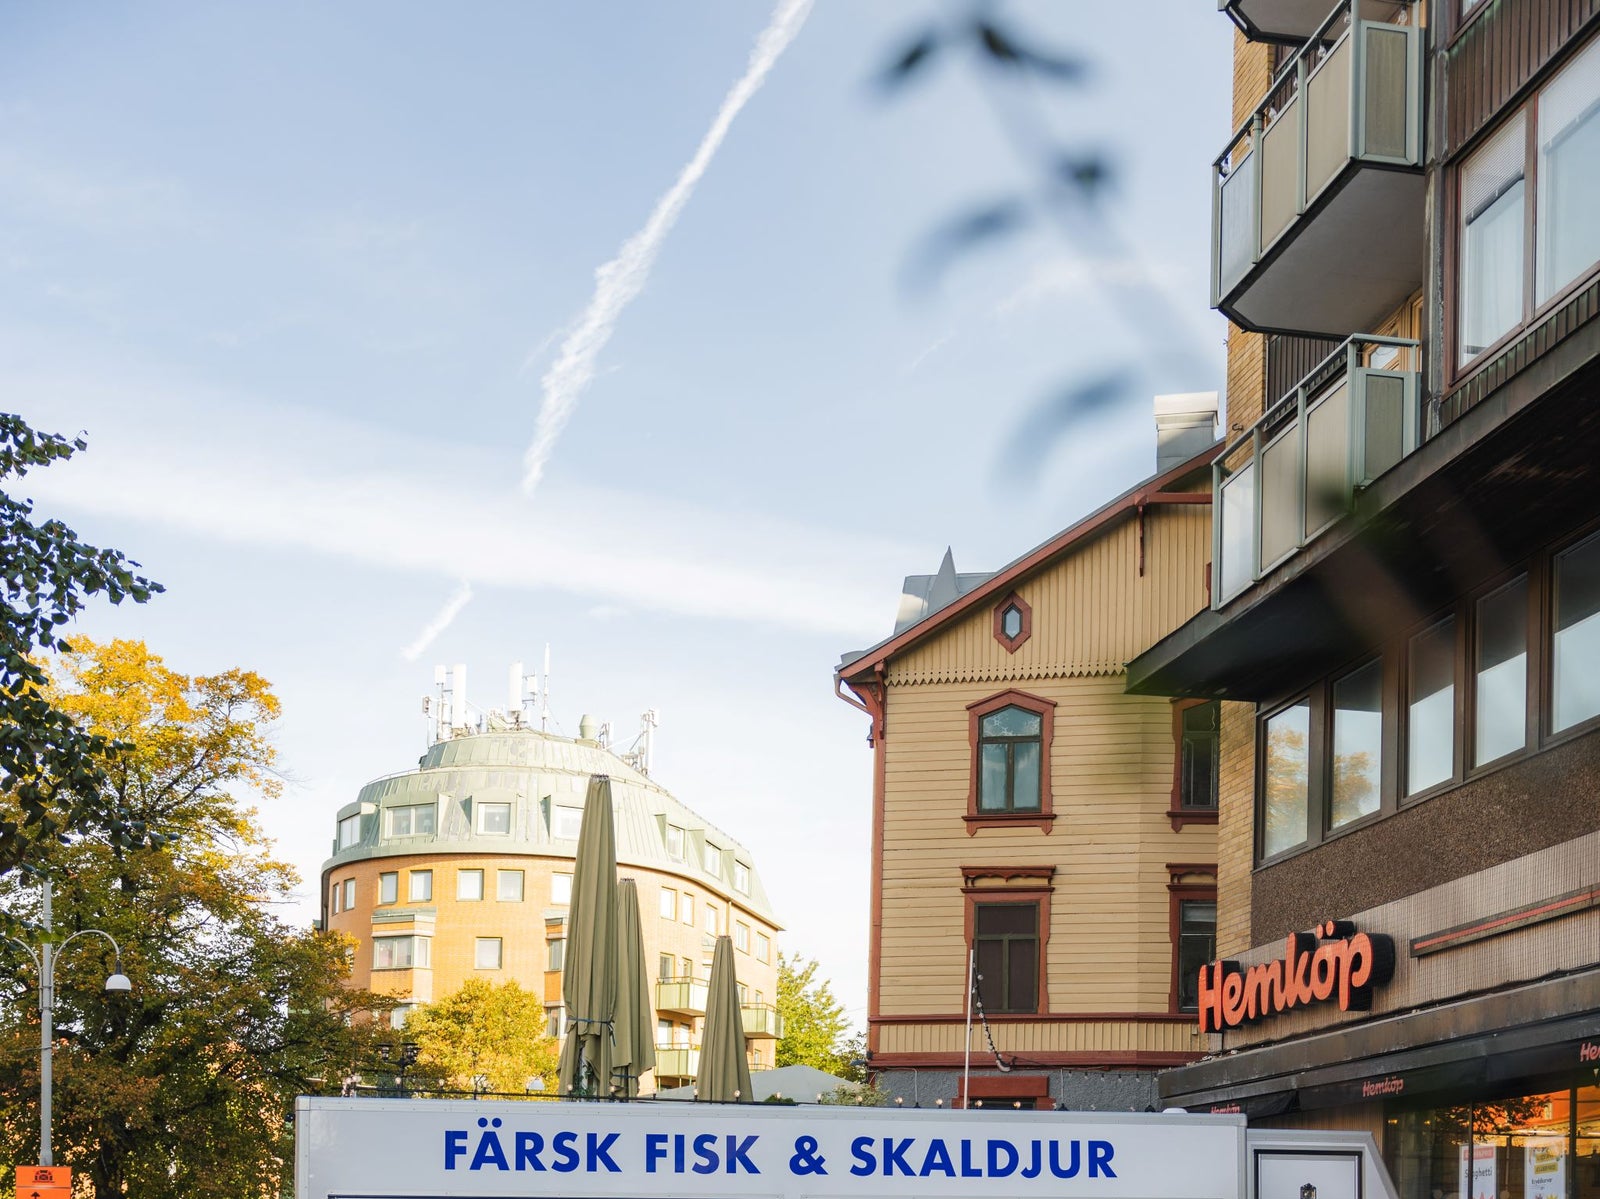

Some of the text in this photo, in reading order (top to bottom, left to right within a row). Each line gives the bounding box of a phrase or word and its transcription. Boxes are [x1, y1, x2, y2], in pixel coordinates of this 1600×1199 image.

[1198, 920, 1372, 1033] Hemköp
[1580, 1041, 1600, 1062] He
[1362, 1076, 1404, 1098] Hemköp
[444, 1117, 1118, 1179] FÄRSK FISK & SKALDJUR
